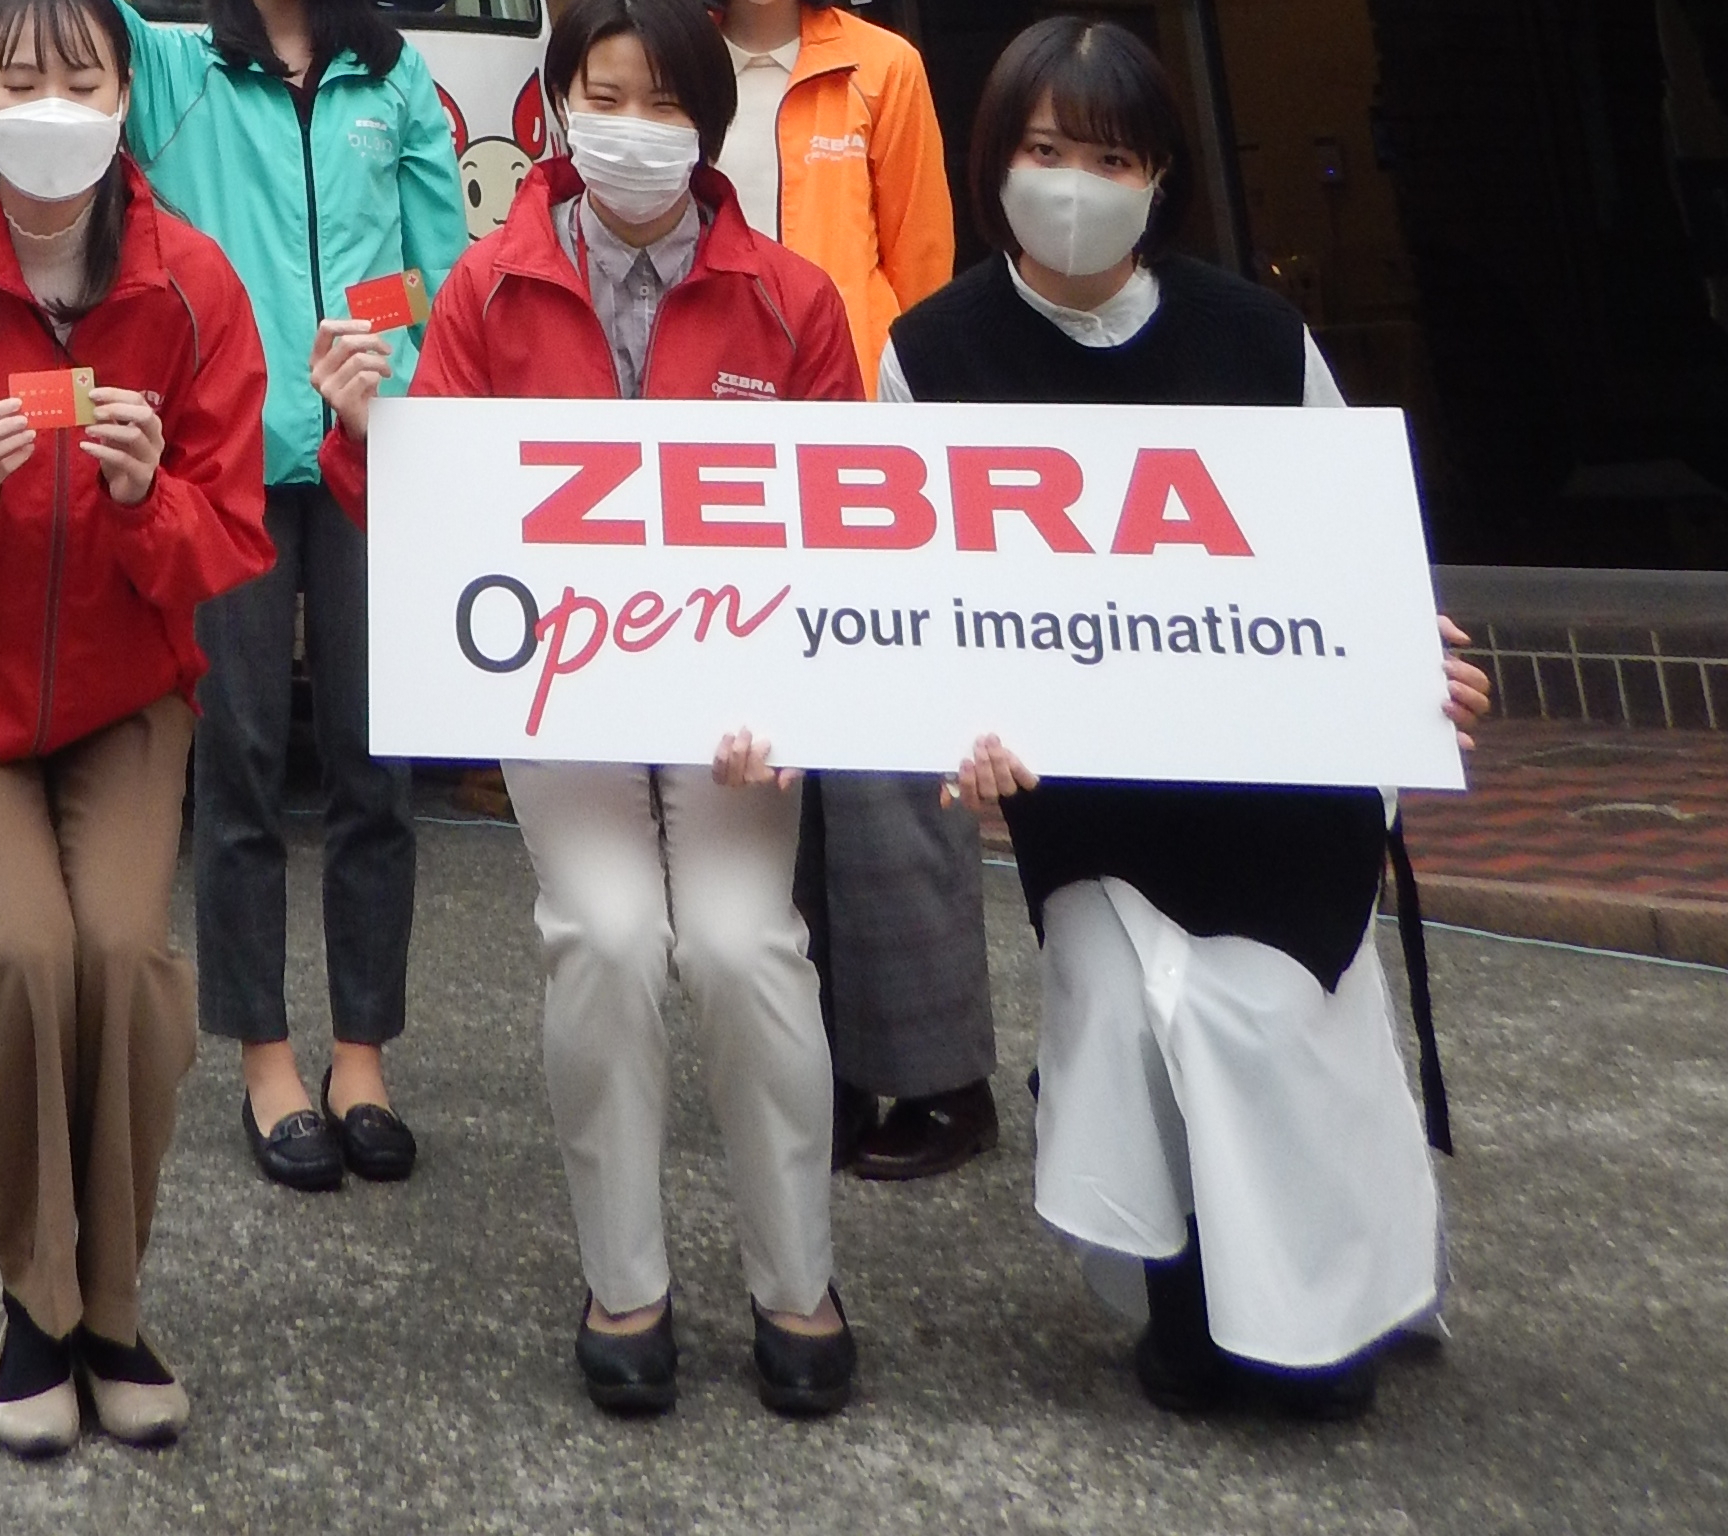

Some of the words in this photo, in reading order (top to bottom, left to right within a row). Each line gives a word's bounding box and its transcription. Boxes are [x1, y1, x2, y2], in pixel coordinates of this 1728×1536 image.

[717, 371, 776, 394] ZEBRA
[518, 440, 1255, 557] ZEBRA
[455, 573, 792, 737] Open
[795, 606, 931, 658] your
[953, 597, 1347, 665] imagination.
